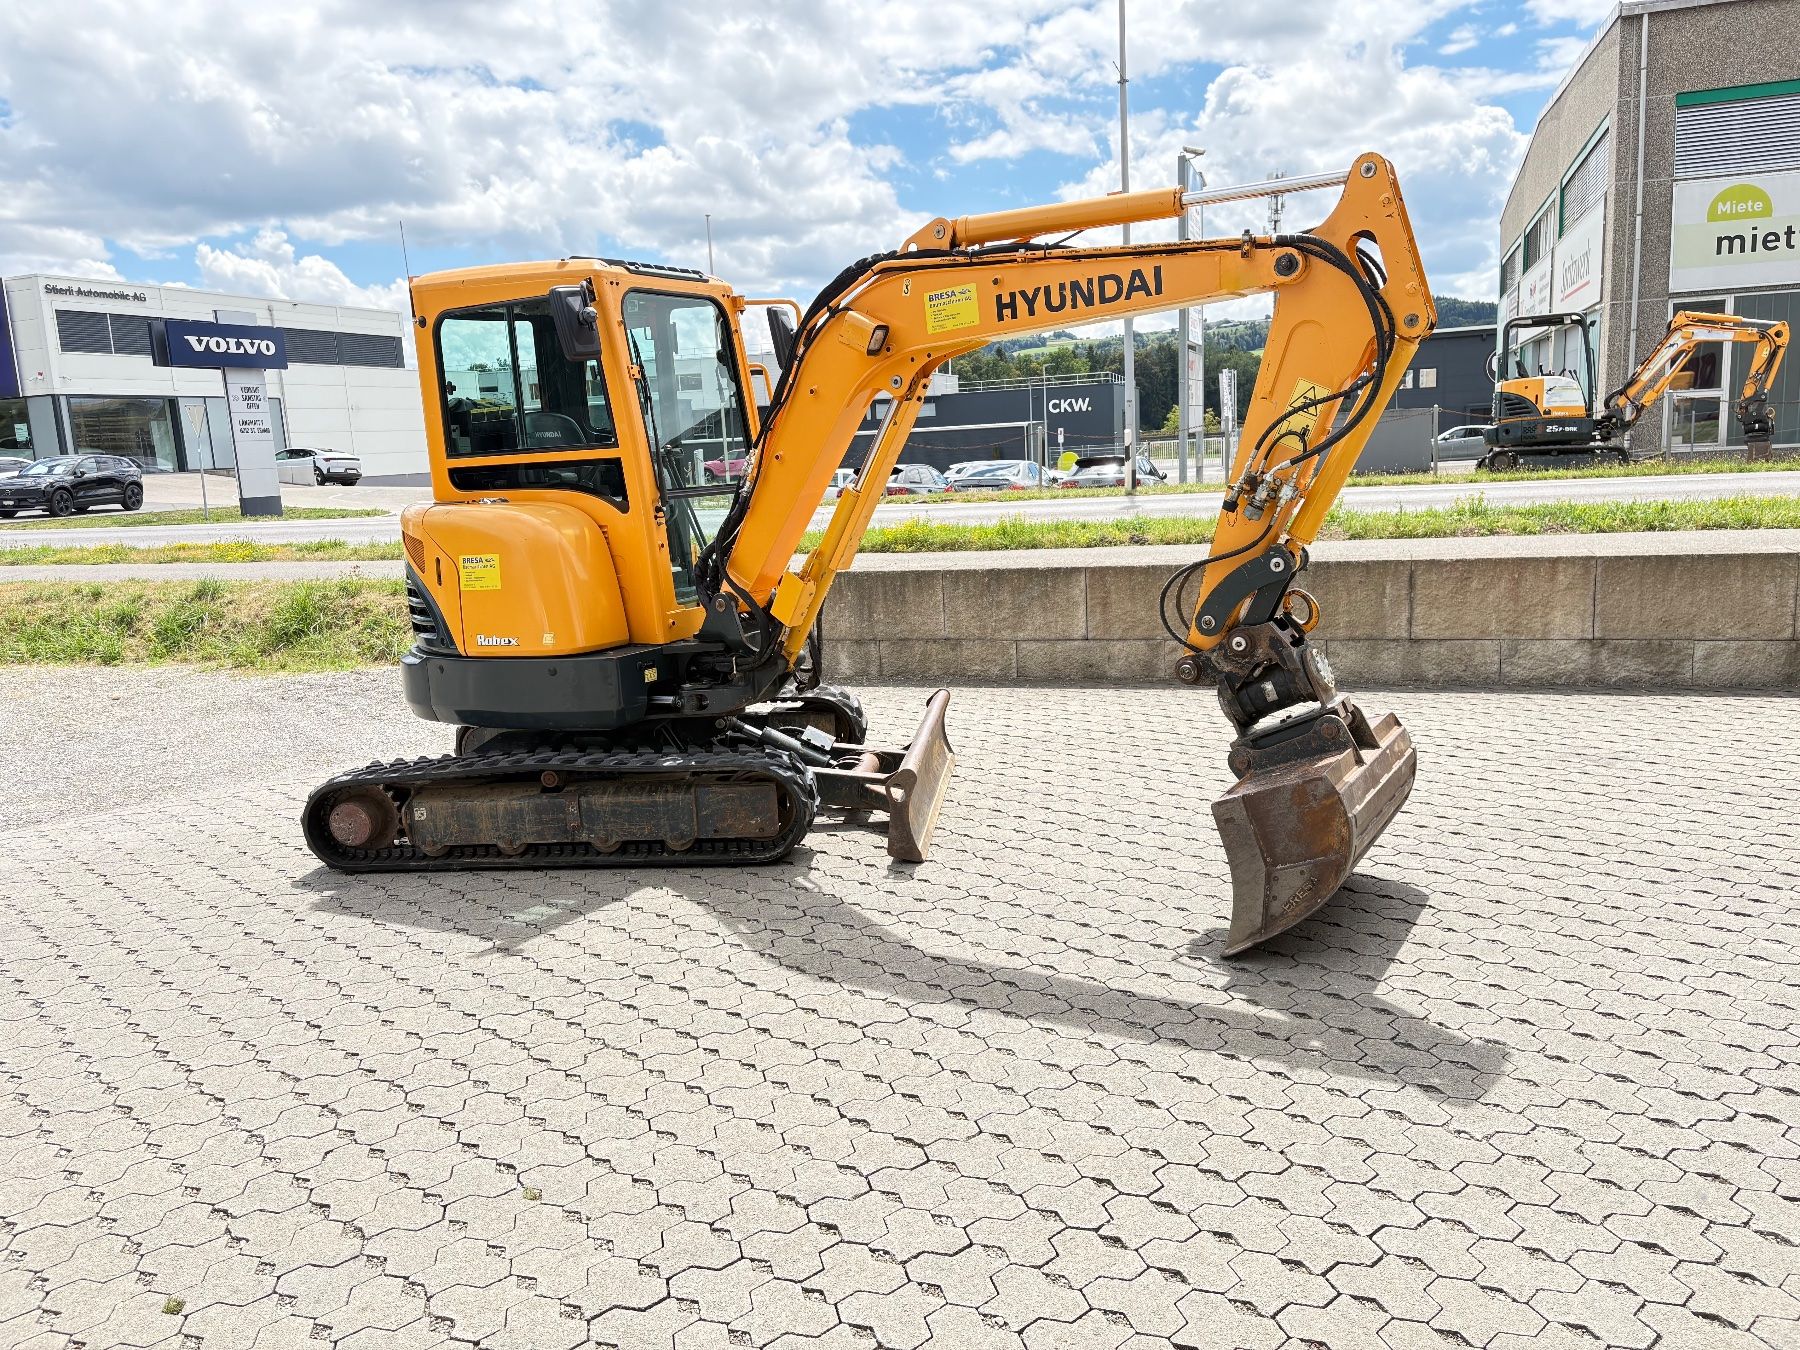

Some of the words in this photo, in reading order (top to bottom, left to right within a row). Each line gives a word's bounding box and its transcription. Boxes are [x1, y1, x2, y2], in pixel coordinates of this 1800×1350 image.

[1717, 200, 1764, 215] Miete
[1716, 225, 1800, 255] miet
[44, 284, 75, 295] Stierli
[76, 287, 131, 301] Automobile
[132, 292, 147, 302] AG
[928, 289, 957, 303] BRESA
[995, 265, 1163, 322] HYUNDAI
[183, 335, 276, 356] VOLVO
[1048, 397, 1092, 414] CKW.
[534, 430, 562, 438] HYUNDAI
[462, 556, 484, 564] BRESA
[476, 634, 520, 647] Robex
